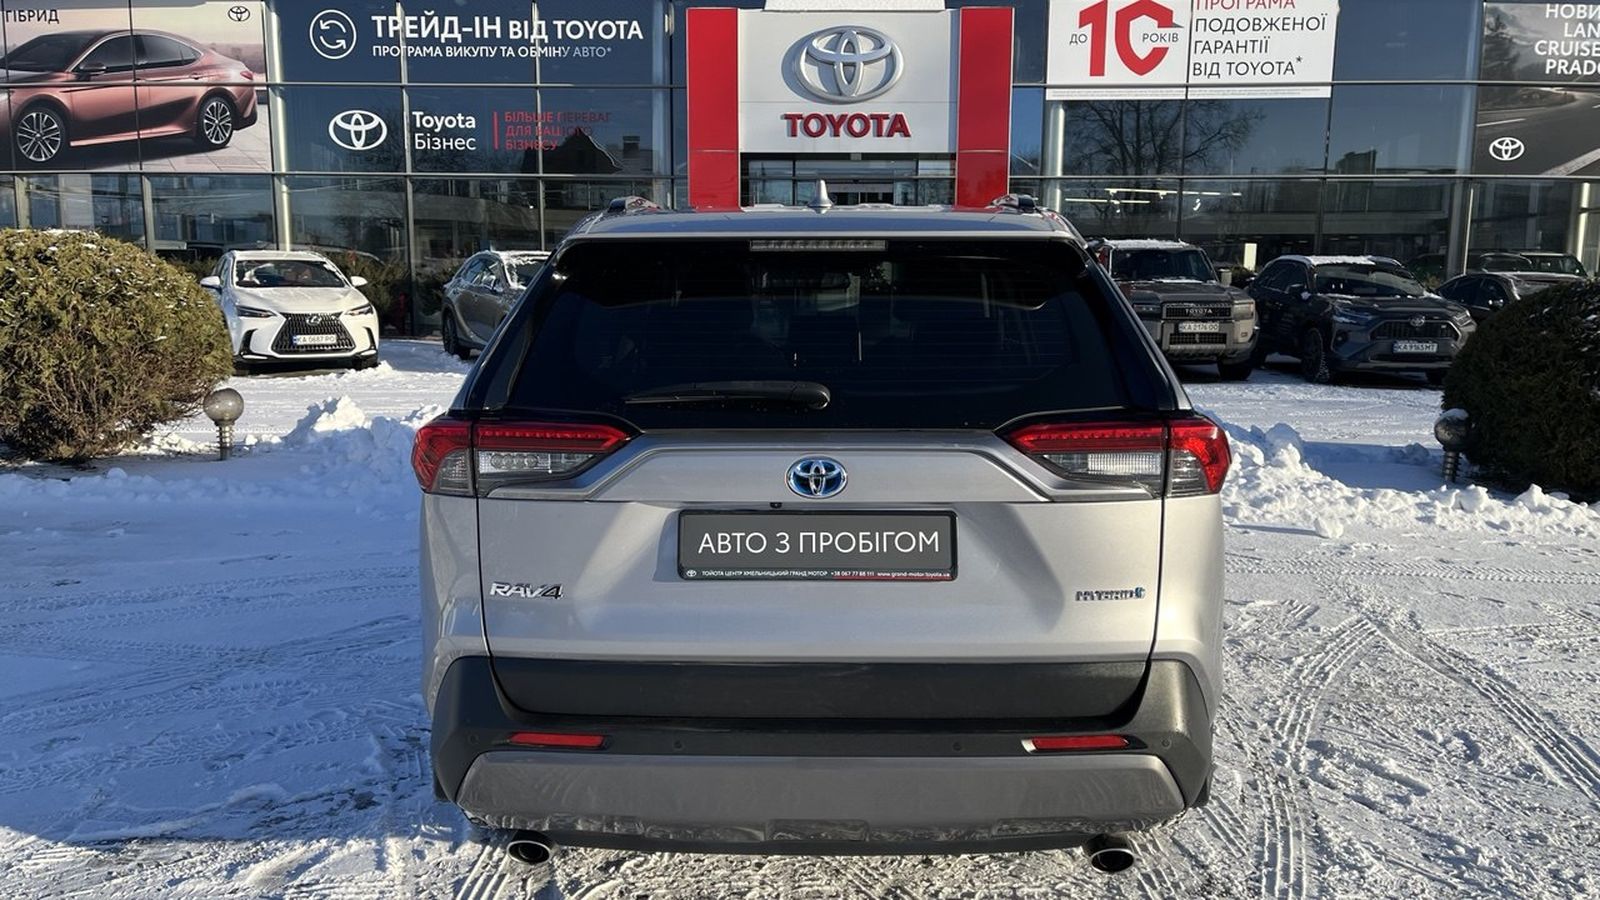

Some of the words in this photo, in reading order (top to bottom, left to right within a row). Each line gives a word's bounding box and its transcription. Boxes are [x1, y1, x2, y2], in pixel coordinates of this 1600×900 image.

[6, 9, 60, 24] ГІБРИД
[1545, 4, 1600, 19] НОВИ
[371, 11, 501, 43] ТРЕЙД-ІН
[509, 20, 549, 42] ВІД
[552, 20, 644, 40] TOYOTA
[1195, 13, 1328, 35] ПОДОВЖЕНОЇ
[1564, 22, 1600, 38] LAN
[1069, 34, 1088, 45] ДО
[1142, 33, 1180, 43] РОКІВ
[1193, 35, 1271, 54] ГАРАНТІЇ
[372, 46, 443, 57] ПРОГРАМА
[446, 46, 498, 57] ВИКУПУ
[500, 46, 515, 57] ТА
[518, 46, 569, 57] ОБМІНУ
[1534, 40, 1600, 57] CRUISE
[1193, 61, 1221, 79] ВІД
[1545, 59, 1600, 76] PRAD
[412, 111, 476, 132] Toyota
[504, 112, 553, 122] БІЛЬШЕ
[557, 111, 612, 122] ПЕРЕВАГ
[781, 112, 911, 138] TOYOTA
[505, 126, 532, 137] ДЛЯ
[414, 132, 477, 151] Бізнес
[698, 532, 767, 554] АВТО
[775, 532, 791, 553] З
[799, 531, 939, 553] ПРОБІГОМ
[490, 582, 563, 599] RAV4
[1075, 589, 1134, 601] HYBRID
